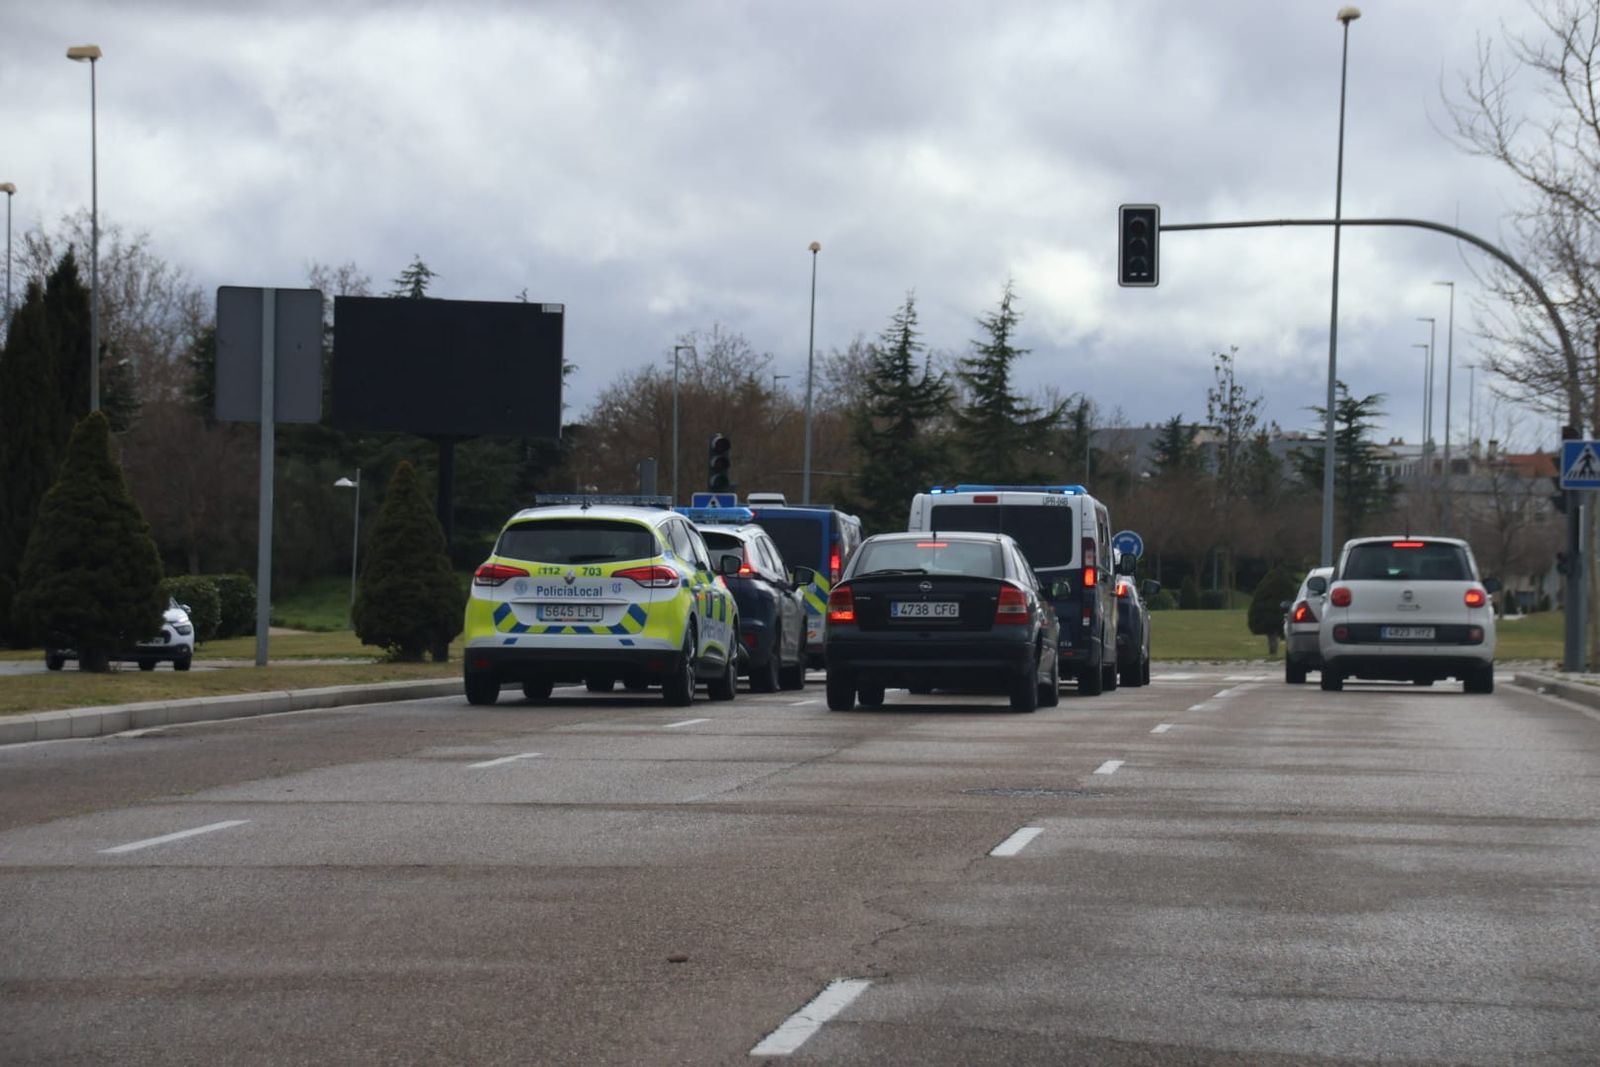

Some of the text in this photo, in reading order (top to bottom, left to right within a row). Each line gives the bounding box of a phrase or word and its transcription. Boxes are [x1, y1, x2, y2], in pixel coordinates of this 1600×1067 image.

[541, 567, 560, 575] 112
[582, 568, 602, 576] 703
[577, 607, 600, 617] LPL
[901, 604, 957, 616] 4738 CFG
